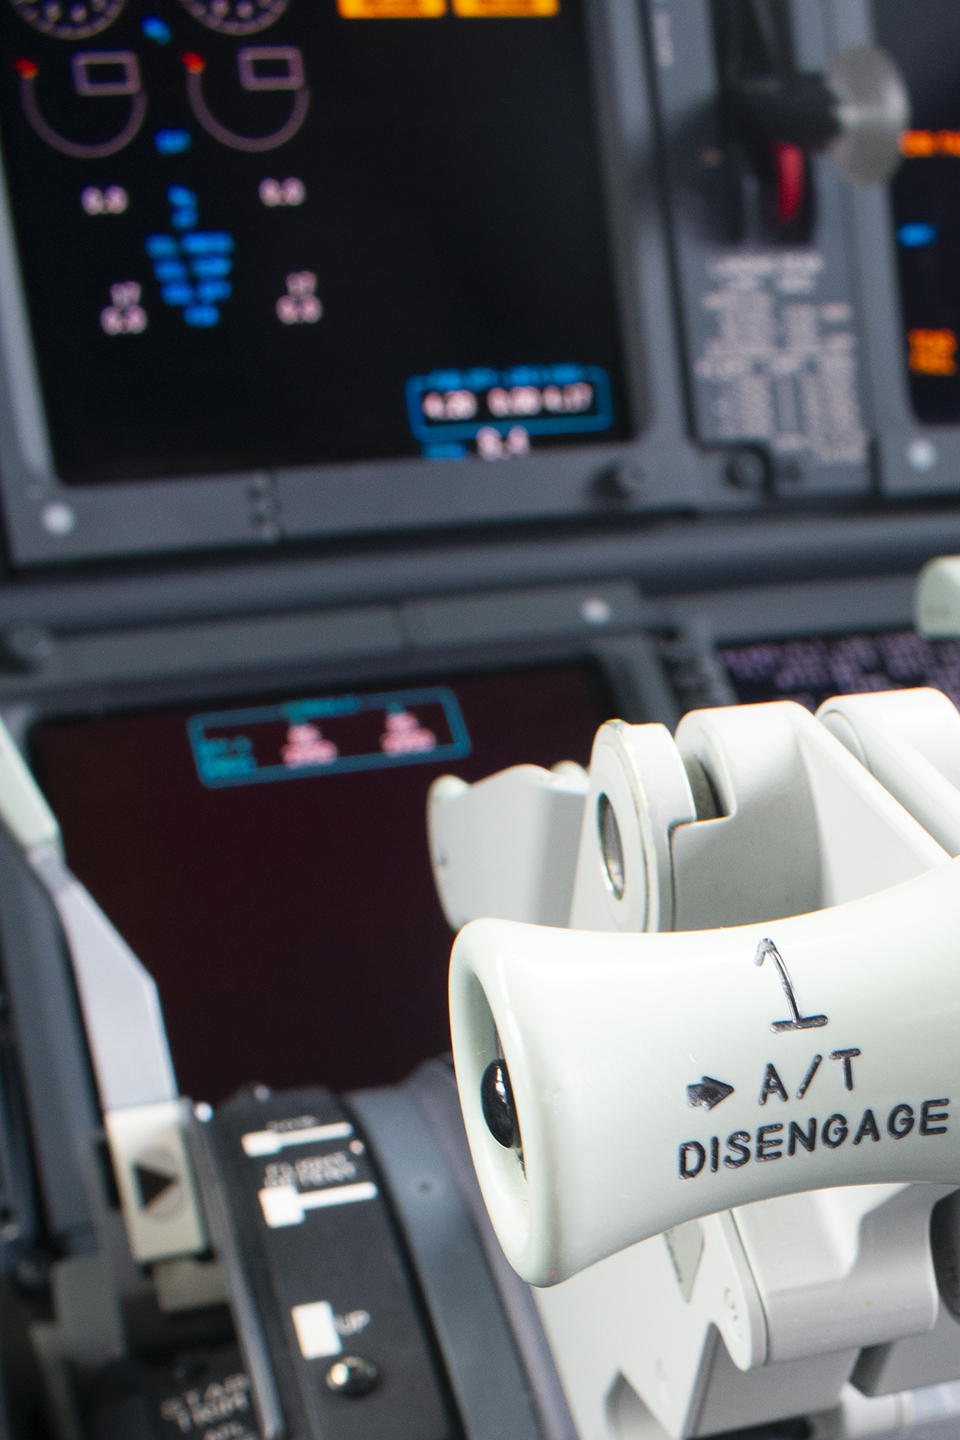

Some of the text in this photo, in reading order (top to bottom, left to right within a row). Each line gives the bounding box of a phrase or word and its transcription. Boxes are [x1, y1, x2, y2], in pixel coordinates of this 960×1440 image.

[752, 937, 829, 1035] 1
[757, 1046, 862, 1106] A/T
[677, 1097, 951, 1181] DISENGAGE
[334, 1309, 371, 1336] UP
